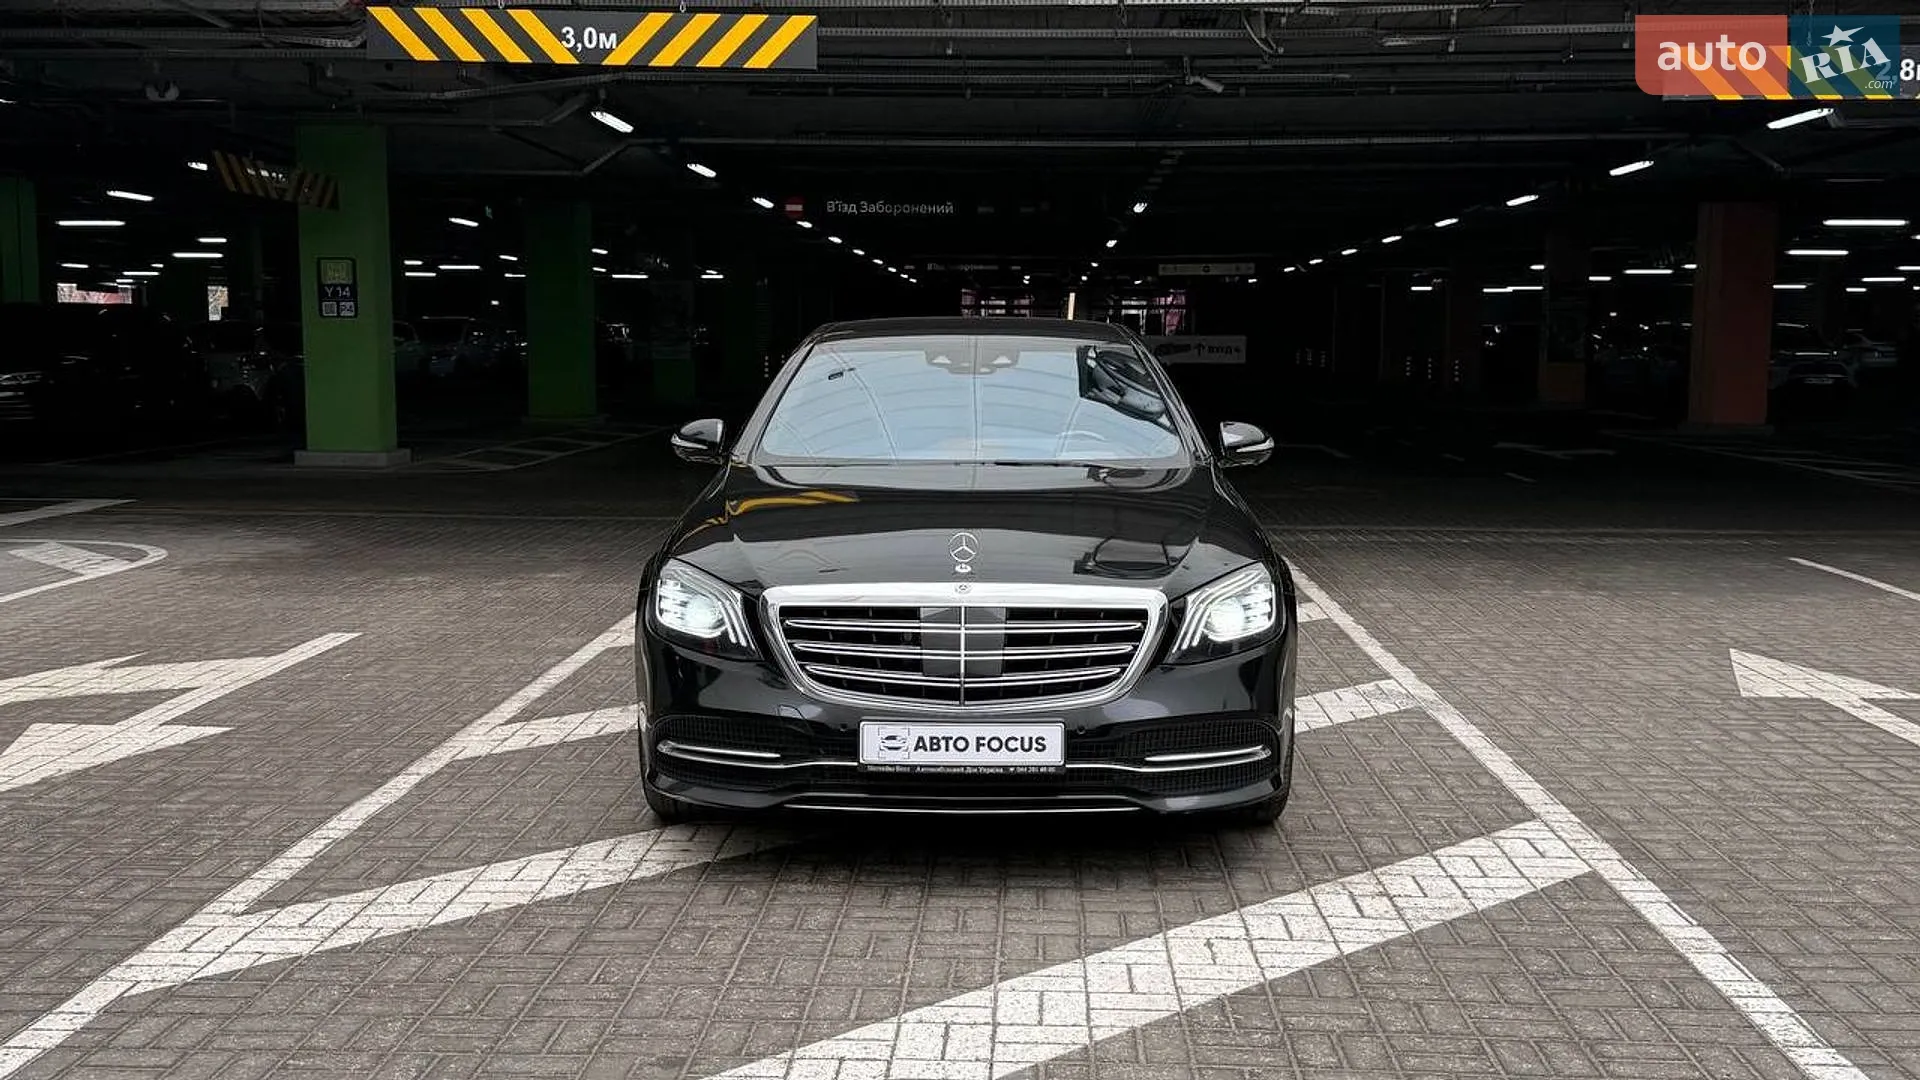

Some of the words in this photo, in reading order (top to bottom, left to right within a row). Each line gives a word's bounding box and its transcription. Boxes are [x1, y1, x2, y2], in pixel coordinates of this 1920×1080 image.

[561, 26, 617, 53] 3,0м
[859, 200, 955, 216] Заборонений
[913, 736, 970, 752] АВТО
[975, 736, 1047, 752] FOCUS
